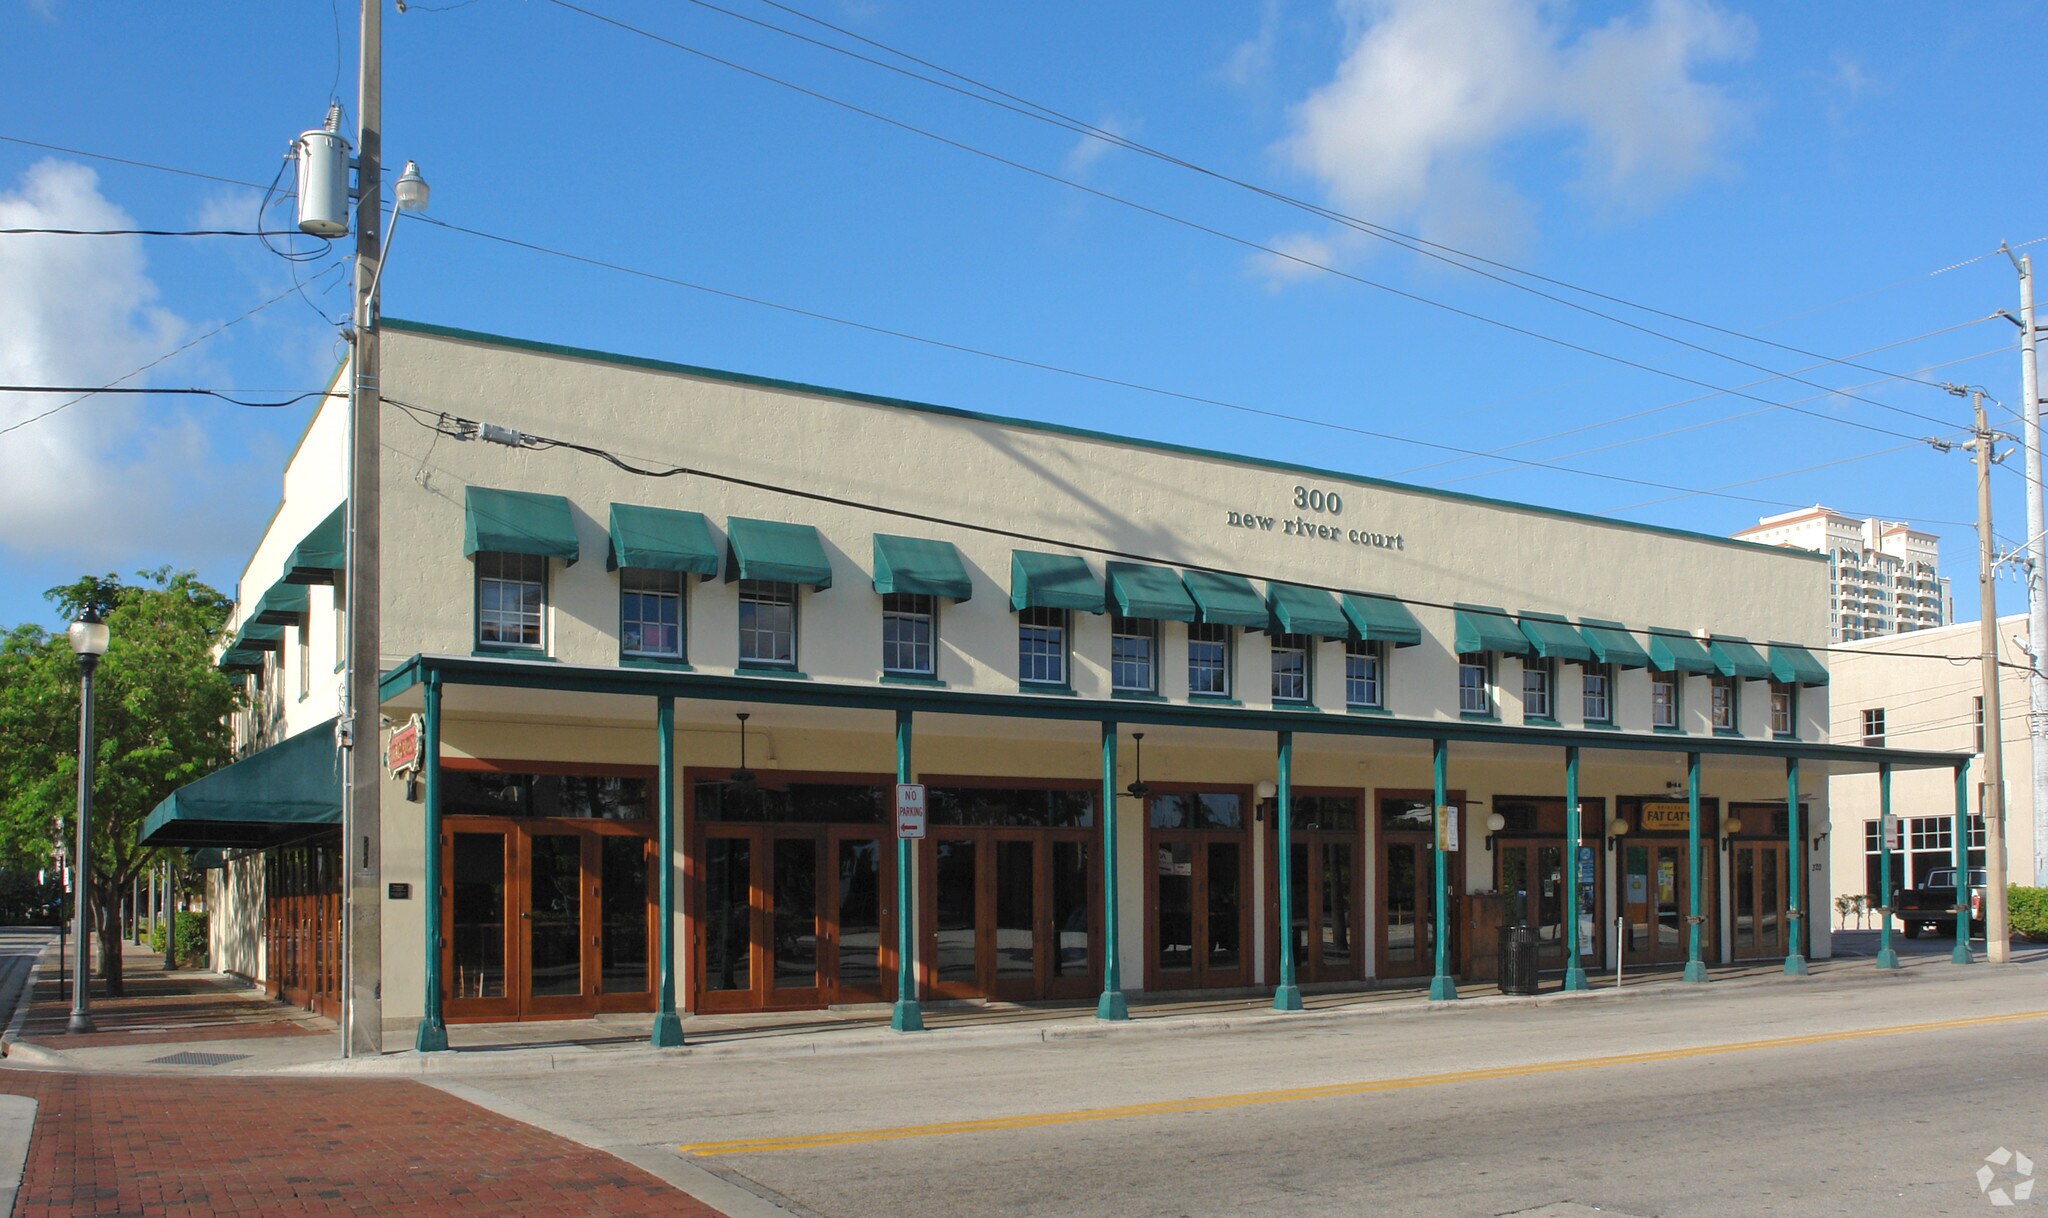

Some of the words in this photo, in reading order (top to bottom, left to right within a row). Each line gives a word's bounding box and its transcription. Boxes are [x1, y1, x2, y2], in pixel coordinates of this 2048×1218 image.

[1293, 485, 1341, 514] 300
[1226, 510, 1274, 531] new
[1282, 516, 1340, 541] river
[1347, 528, 1404, 550] court
[905, 791, 917, 801] NO
[900, 806, 923, 817] PARKING
[1647, 811, 1665, 821] FAT
